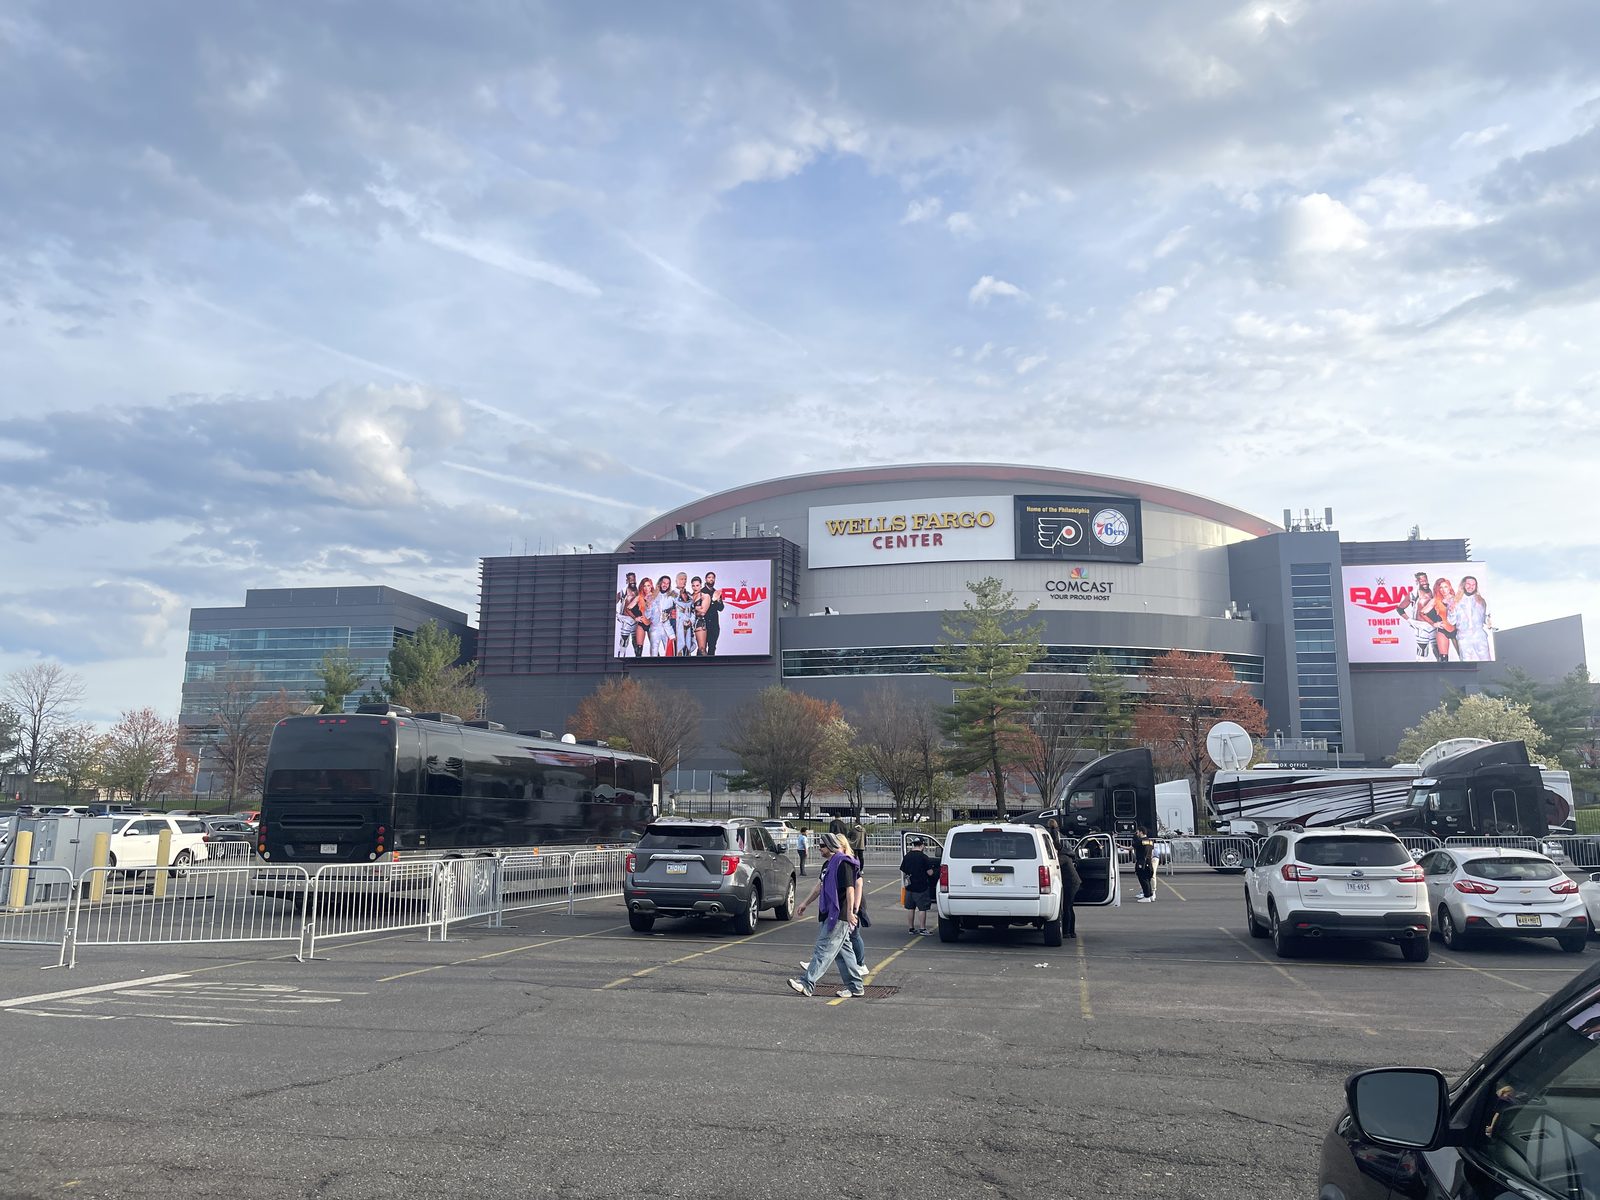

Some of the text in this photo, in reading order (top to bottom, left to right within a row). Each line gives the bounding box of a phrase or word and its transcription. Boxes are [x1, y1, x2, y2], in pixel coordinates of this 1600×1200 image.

[826, 511, 995, 536] WELLS FARGO
[1096, 522, 1125, 537] 76ers
[872, 533, 943, 549] CENTER
[722, 587, 767, 602] RAW
[1045, 580, 1114, 594] COMCAST
[1350, 587, 1413, 605] RAW
[1368, 618, 1400, 626] TONIGHT
